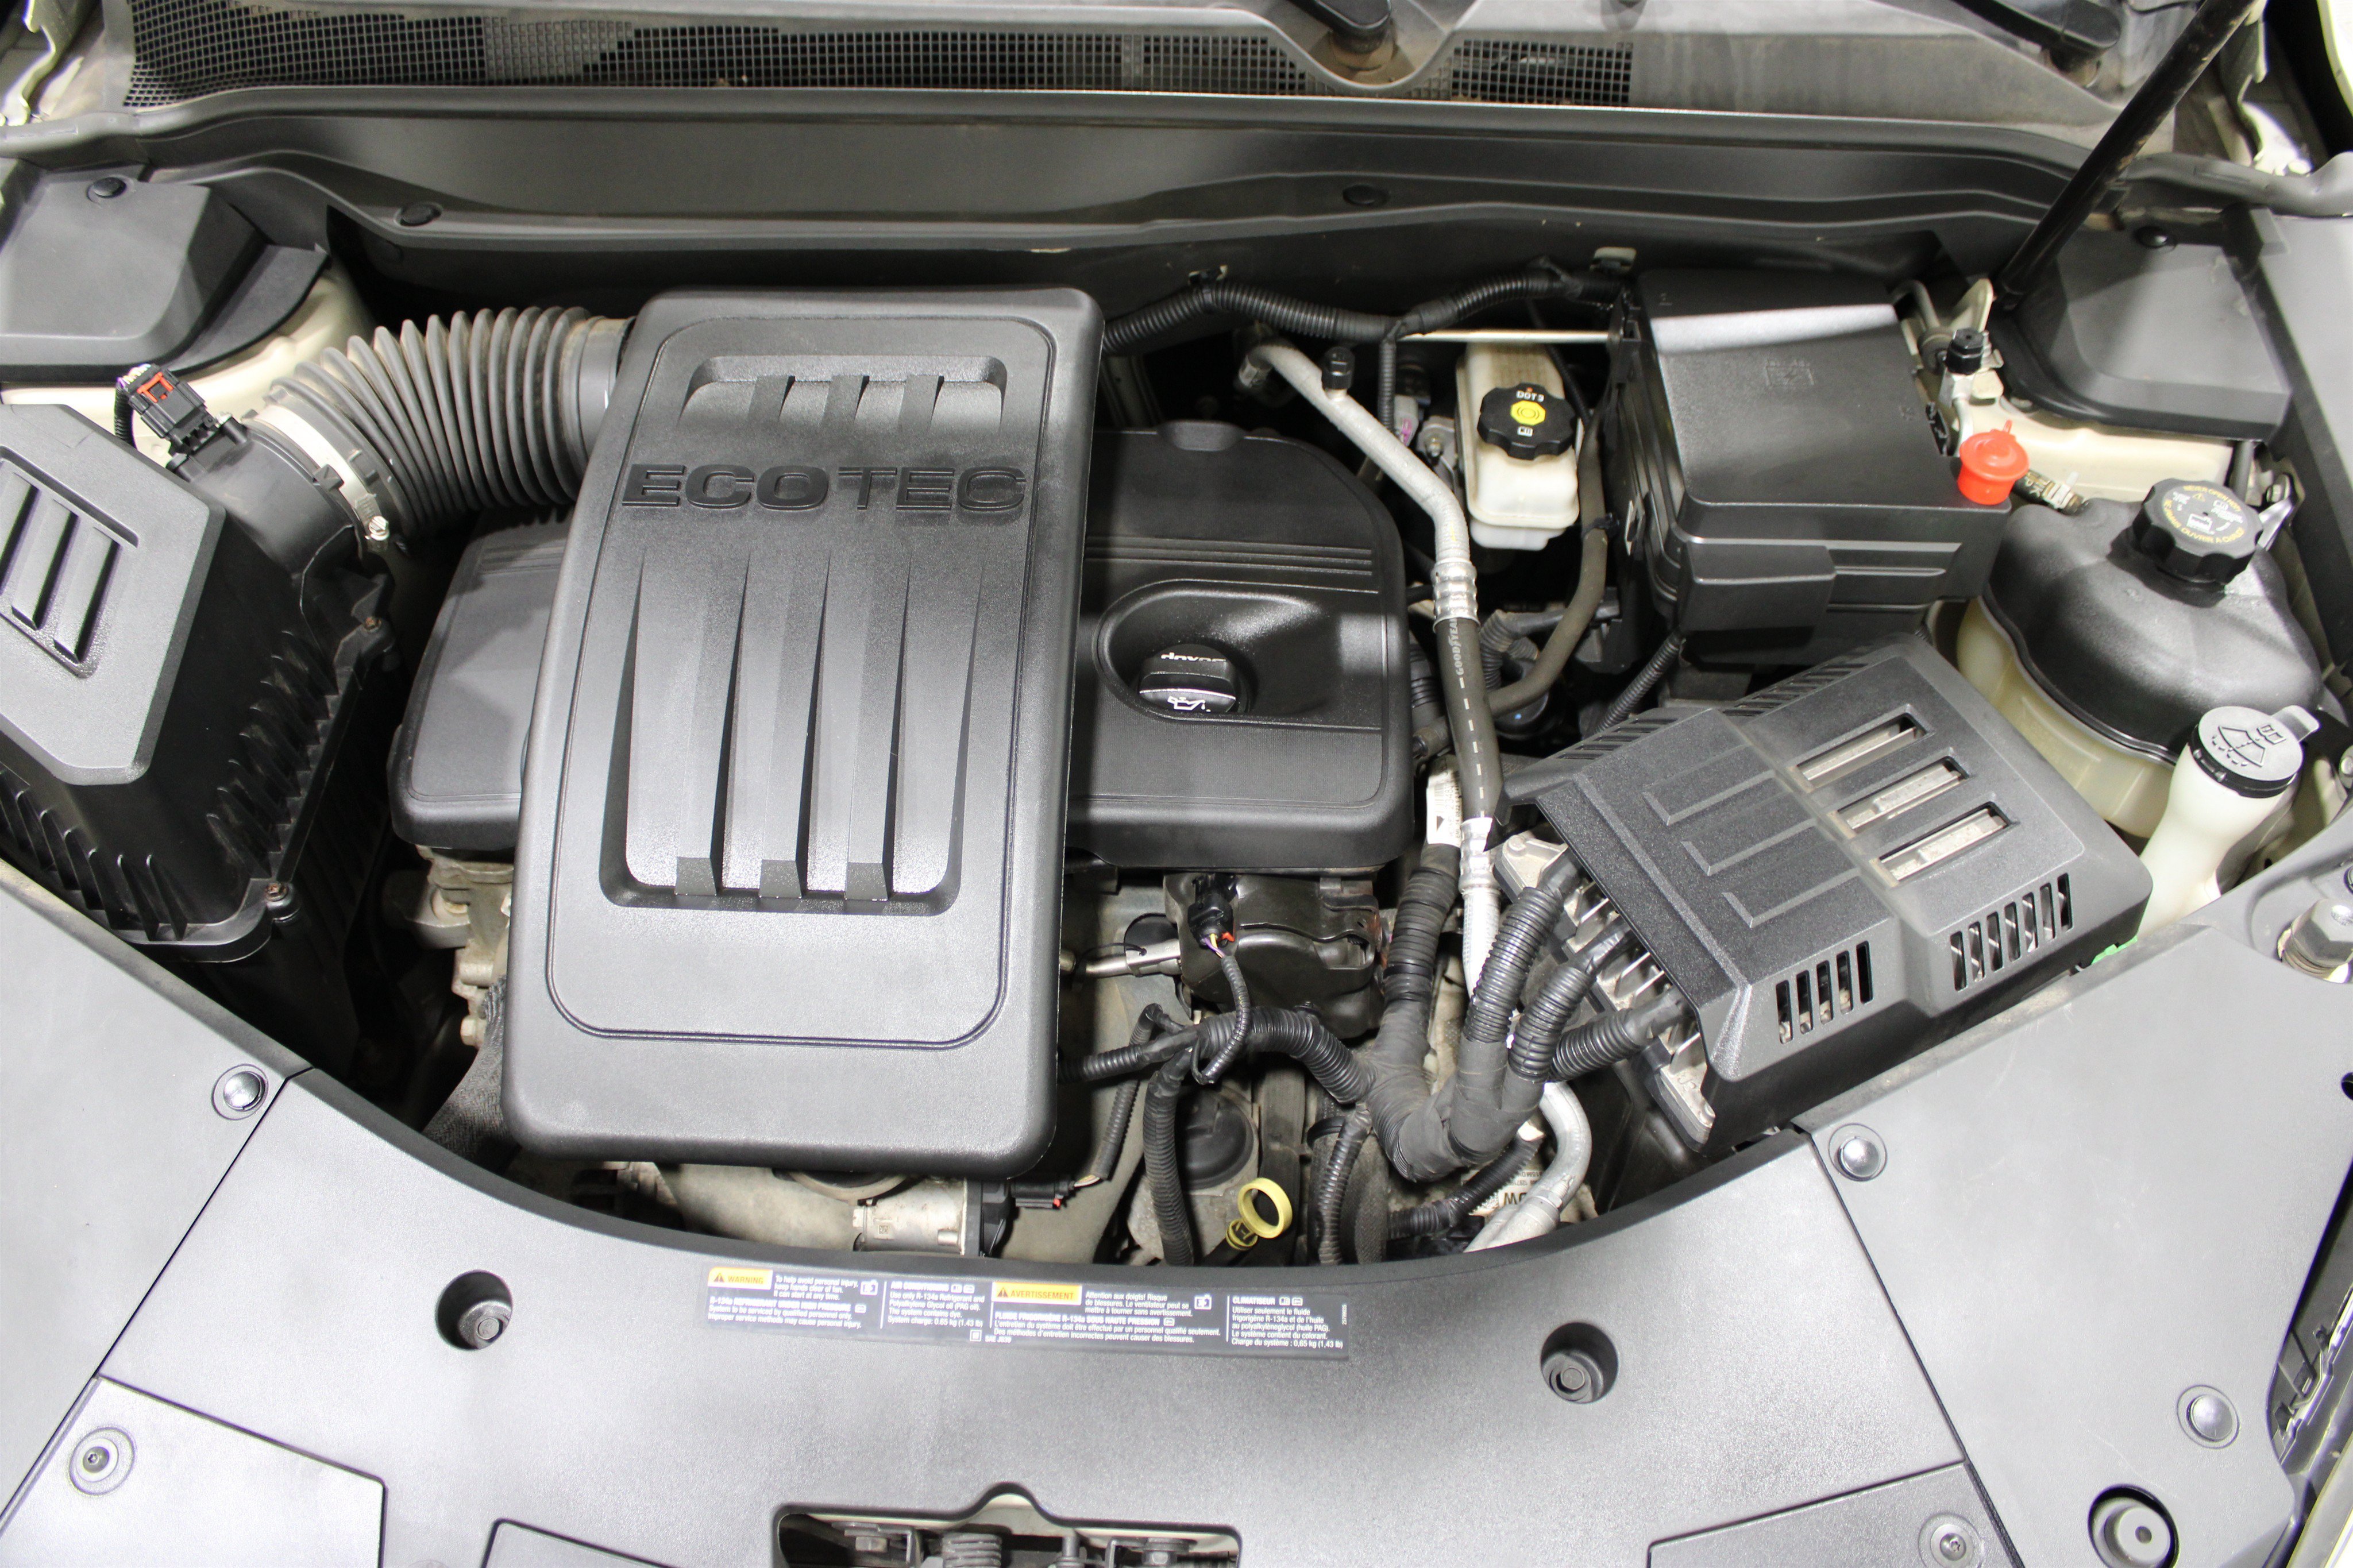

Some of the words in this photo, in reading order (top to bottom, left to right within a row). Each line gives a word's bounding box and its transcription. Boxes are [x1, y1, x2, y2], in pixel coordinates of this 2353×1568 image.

[1516, 391, 1538, 401] DOT
[1537, 394, 1545, 403] 3
[622, 464, 1027, 512] ECOTEC
[728, 1276, 763, 1285] WARNING
[783, 1276, 797, 1285] help
[814, 1278, 839, 1287] personal
[840, 1279, 858, 1288] injury,
[774, 1283, 789, 1292] keep
[902, 1292, 915, 1301] only
[939, 1294, 971, 1303] Refrigerant
[1010, 1290, 1074, 1300] AVERTISSEMENT
[1125, 1293, 1145, 1301] doigts!
[1147, 1293, 1167, 1302] Risque
[926, 1301, 944, 1310] Glycol
[954, 1302, 969, 1311] (PAG
[970, 1303, 980, 1311] oil).
[1134, 1300, 1166, 1308] ventilateur
[1167, 1301, 1181, 1310] peut
[709, 1306, 731, 1315] System
[747, 1307, 773, 1315] serviced
[774, 1309, 782, 1317] by
[782, 1309, 808, 1319] qualified
[808, 1311, 838, 1320] personnel
[839, 1312, 852, 1321] only.
[901, 1308, 922, 1317] system
[923, 1309, 948, 1317] contains
[949, 1310, 962, 1319] dye.
[1149, 1308, 1193, 1316] avertissement.
[708, 1313, 735, 1322] Improper
[735, 1314, 757, 1322] service
[757, 1315, 783, 1323] methods
[817, 1319, 843, 1328] personal
[844, 1320, 861, 1329] injury.
[888, 1316, 909, 1325] System
[911, 1317, 932, 1326] charge:
[949, 1319, 957, 1327] kg
[975, 1320, 983, 1328] lb)
[1232, 1315, 1264, 1323] frigorigène
[1036, 1322, 1060, 1331] système
[1134, 1326, 1163, 1335] personnel
[1164, 1327, 1186, 1335] qualifié
[1296, 1324, 1312, 1332] (huile
[1314, 1324, 1330, 1333] PAG).
[1006, 1328, 1036, 1337] méthodes
[1037, 1330, 1069, 1338] d'entretien
[1104, 1333, 1129, 1341] peuvent
[1241, 1330, 1265, 1339] système
[1232, 1338, 1252, 1346] Charge
[1264, 1339, 1289, 1347] système
[1309, 1340, 1316, 1349] kg
[1318, 1341, 1333, 1349] (1,43
[1335, 1341, 1343, 1349] lb)
